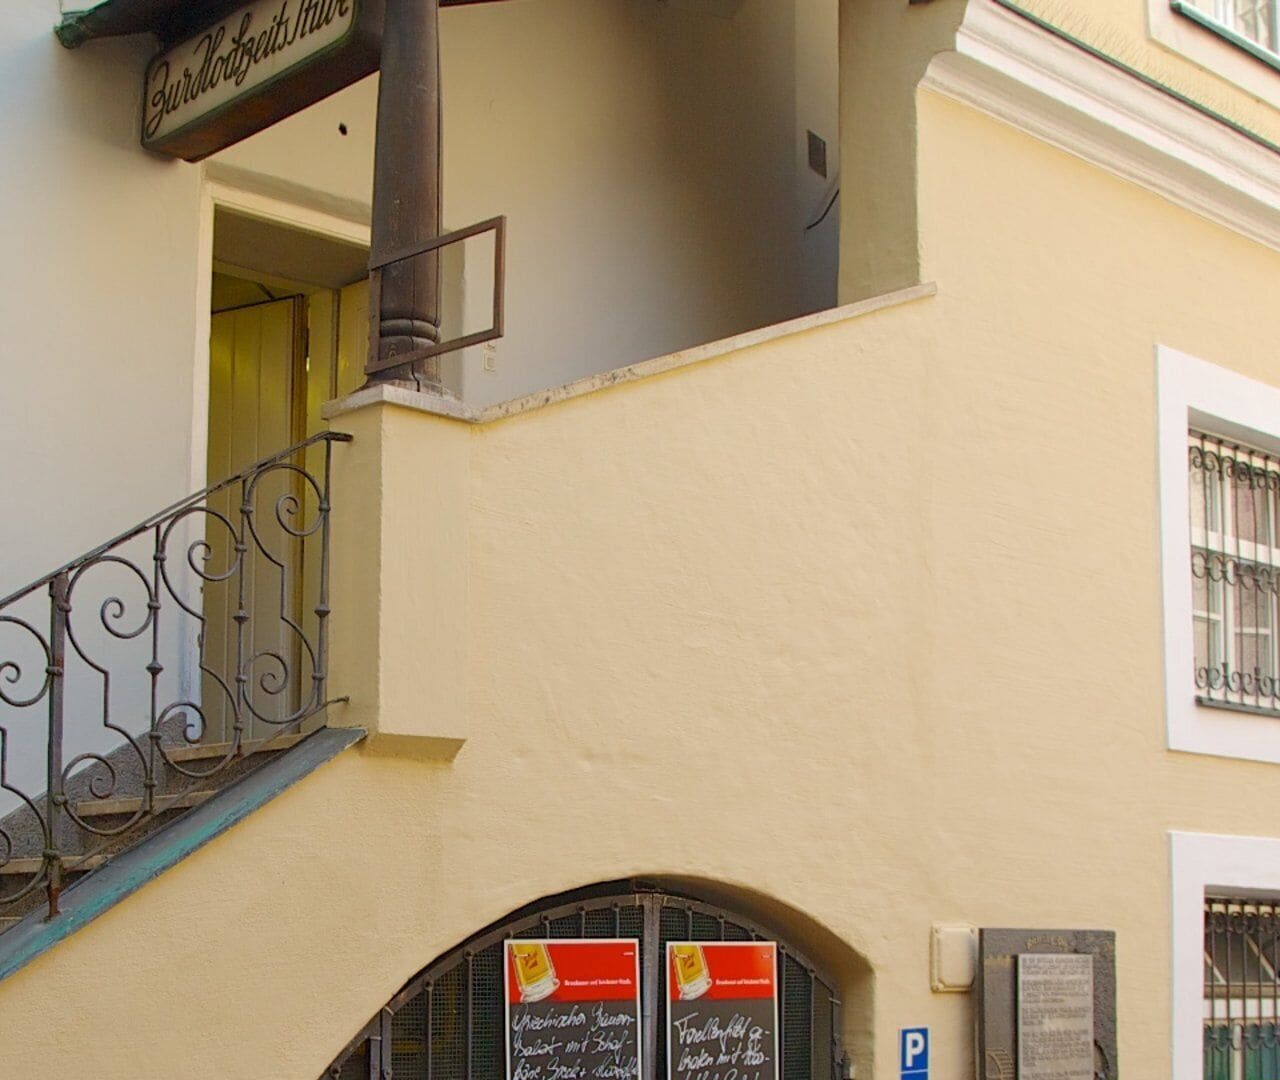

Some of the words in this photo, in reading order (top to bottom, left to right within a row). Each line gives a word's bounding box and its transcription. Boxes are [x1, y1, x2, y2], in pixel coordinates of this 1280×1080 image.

[145, 60, 192, 138] Zur
[565, 1031, 591, 1055] mit
[905, 1032, 925, 1068] P
